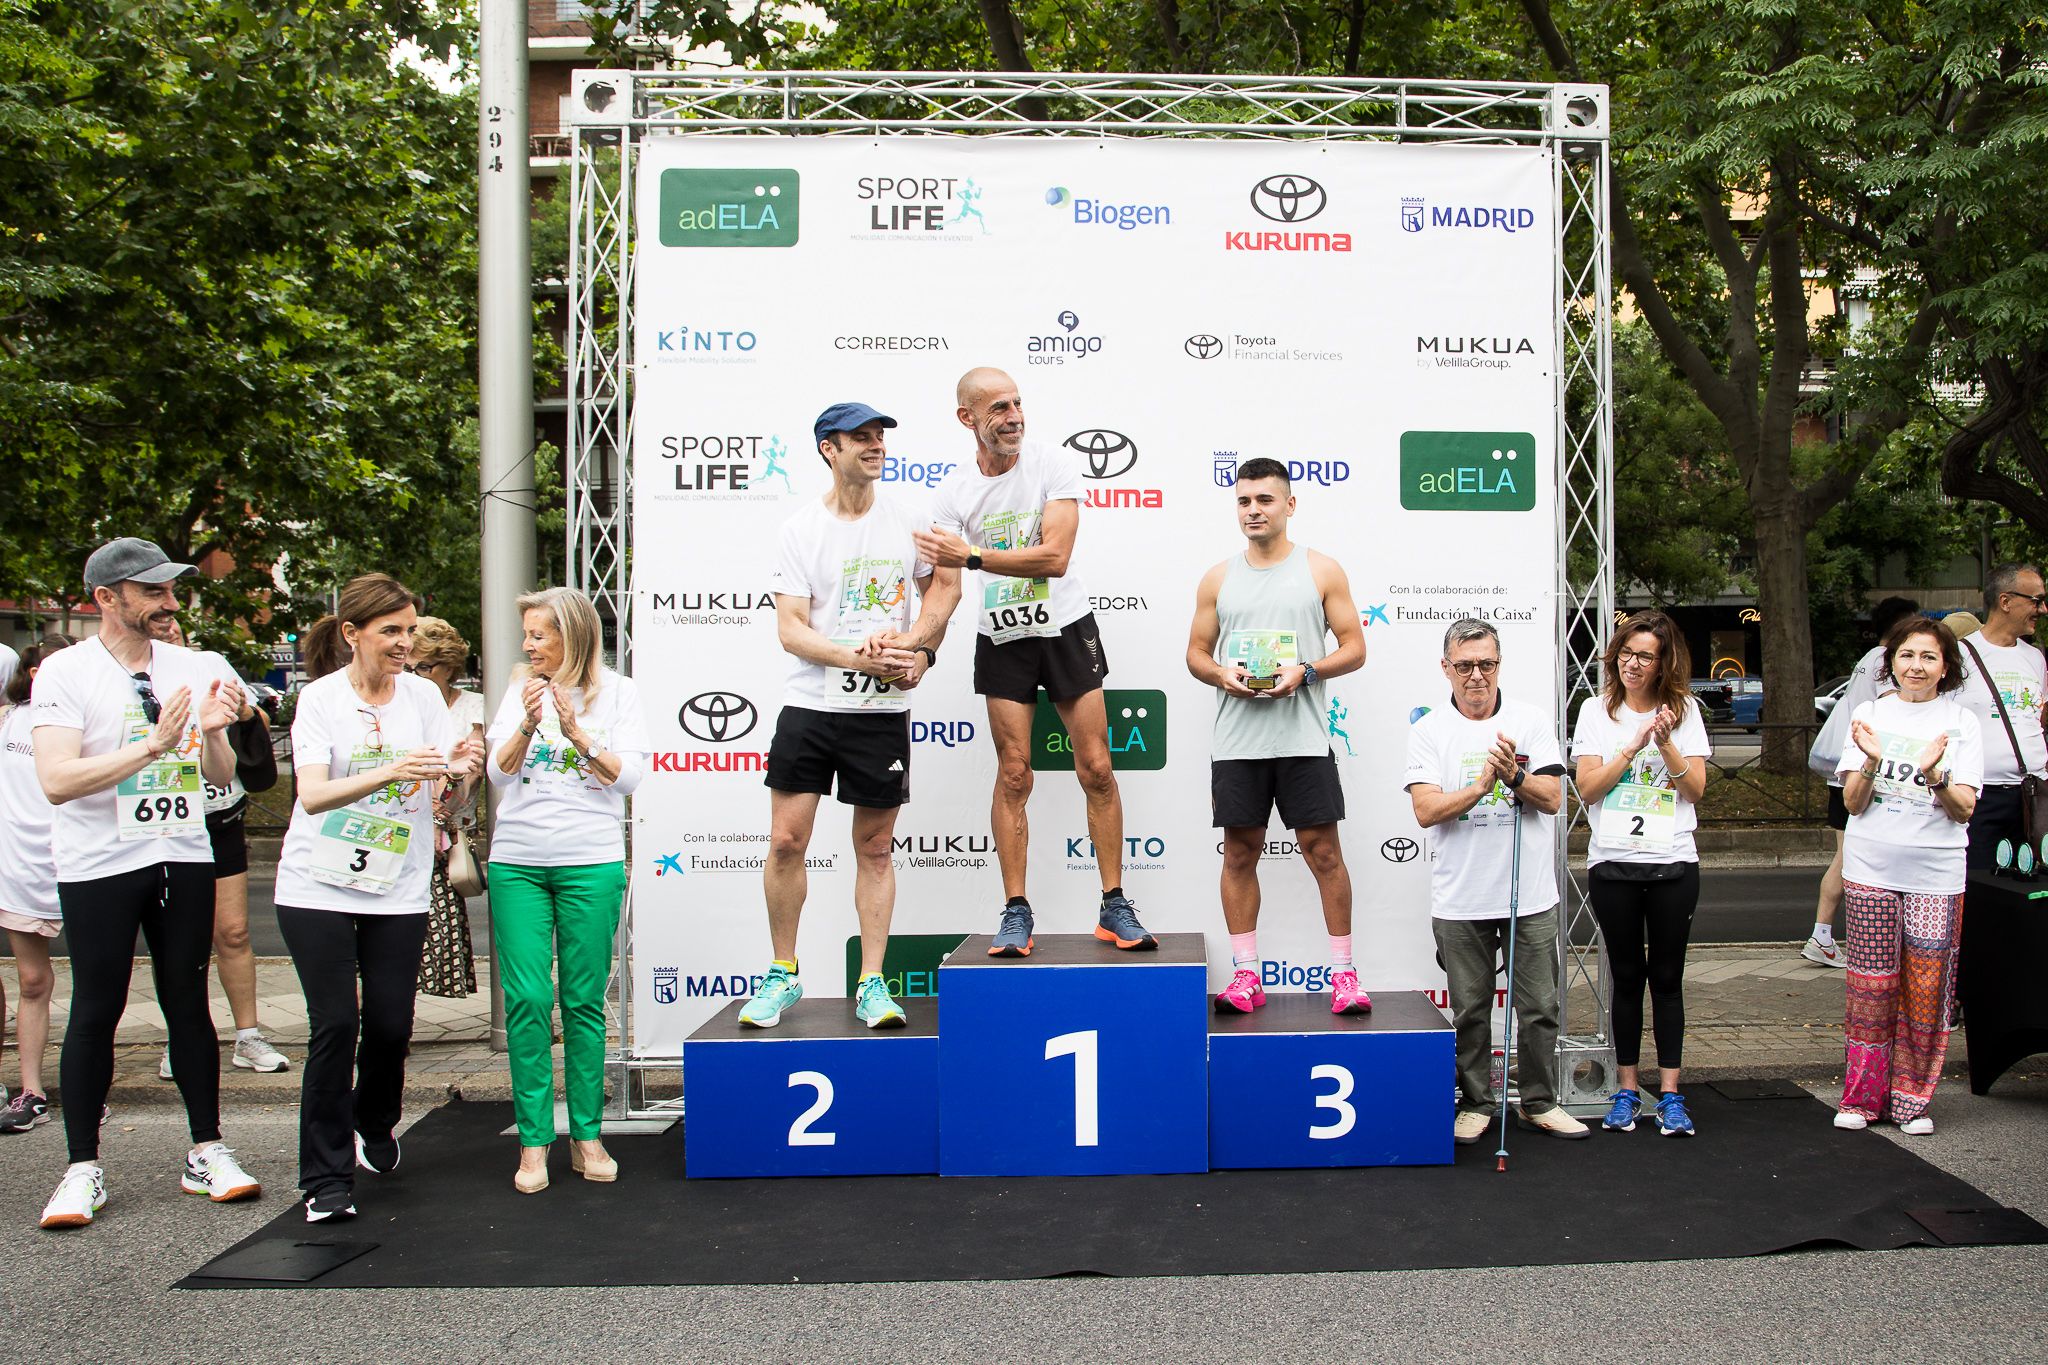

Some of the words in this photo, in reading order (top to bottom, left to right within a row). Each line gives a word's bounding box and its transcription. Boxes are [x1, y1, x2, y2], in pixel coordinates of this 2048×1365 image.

[857, 177, 957, 200] SPORT
[679, 204, 780, 230] adELA
[872, 205, 943, 230] LIFE
[1074, 199, 1171, 230] Biogen
[1432, 206, 1534, 233] MADRID
[1028, 335, 1102, 358] amigo
[1235, 335, 1276, 348] Toyota
[1418, 336, 1535, 355] MUKUA
[1028, 355, 1064, 365] tours
[1235, 349, 1291, 360] Financial
[1293, 349, 1343, 361] Services
[662, 436, 763, 458] SPORT
[675, 464, 748, 489] LIFE
[881, 456, 957, 487] Biog
[1288, 460, 1349, 486] DRID
[1419, 467, 1516, 493] adELA
[983, 515, 1017, 527] MADRID
[653, 593, 776, 610] MUKUA
[996, 580, 1036, 604] ELA
[1389, 584, 1408, 595] Con
[1412, 584, 1420, 594] la
[1423, 584, 1489, 596] colaboración
[1492, 585, 1508, 596] de:
[989, 603, 1050, 632] 1036
[1397, 605, 1469, 620] Fundación
[912, 721, 975, 747] DRID
[351, 751, 392, 759] MADRID
[136, 770, 183, 791] ELA
[134, 796, 189, 822] 698
[1617, 791, 1660, 811] ELA
[340, 816, 394, 848] ELA
[1630, 815, 1645, 836] 2
[684, 833, 706, 843] Con
[708, 833, 717, 843] la
[720, 833, 771, 843] colaborac
[350, 848, 371, 872] 3
[1067, 863, 1096, 871] Flexible
[1262, 960, 1332, 992] Bioge
[1044, 1030, 1099, 1146] 1
[787, 1071, 836, 1147] 2
[1308, 1064, 1357, 1139] 3
